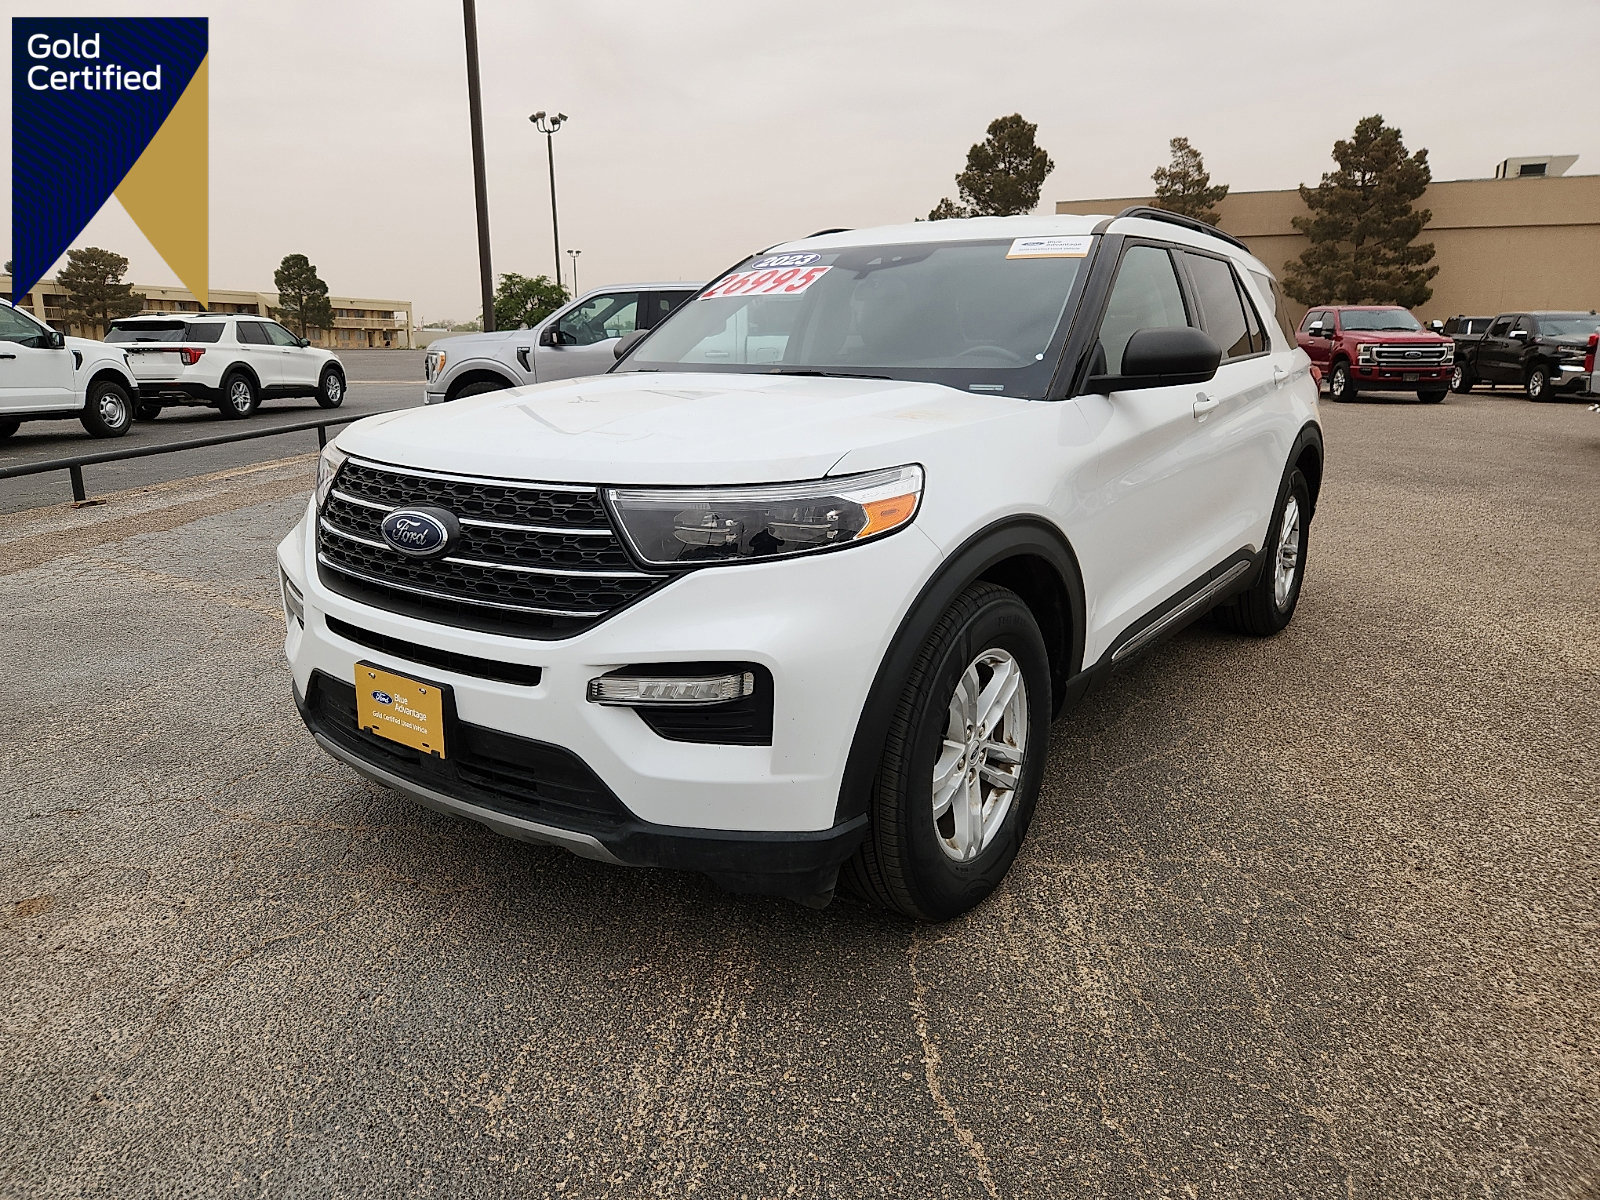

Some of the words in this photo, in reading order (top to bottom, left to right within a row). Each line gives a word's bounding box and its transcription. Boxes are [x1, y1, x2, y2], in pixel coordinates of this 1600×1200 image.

[756, 253, 816, 268] 2023
[702, 267, 828, 298] 26995
[392, 518, 429, 546] Ford
[394, 693, 408, 705] Blue
[372, 711, 383, 719] Gold
[383, 714, 400, 724] Certified
[394, 703, 426, 721] Advantage
